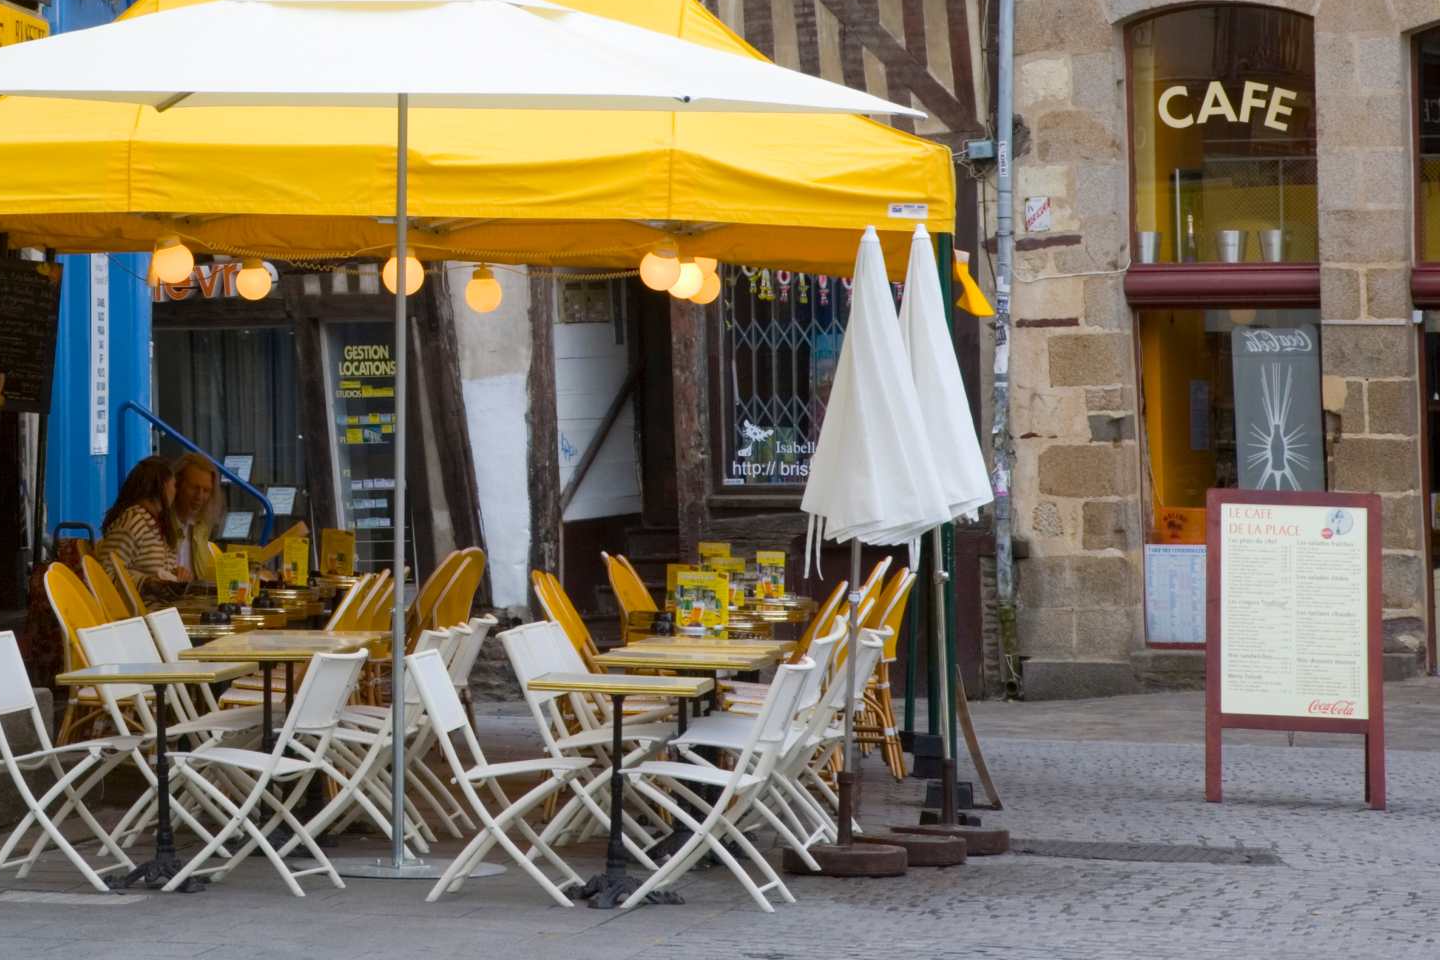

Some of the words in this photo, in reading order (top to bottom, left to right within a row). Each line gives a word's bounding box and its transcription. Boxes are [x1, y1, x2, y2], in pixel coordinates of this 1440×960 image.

[1158, 80, 1298, 132] CAFE
[343, 345, 390, 360] GESTION
[338, 361, 397, 376] LOCATIONS
[732, 461, 777, 478] http://
[1229, 508, 1241, 519] LE
[1229, 524, 1244, 536] DE
[1247, 524, 1262, 536] LA
[1265, 525, 1301, 537] PLACE
